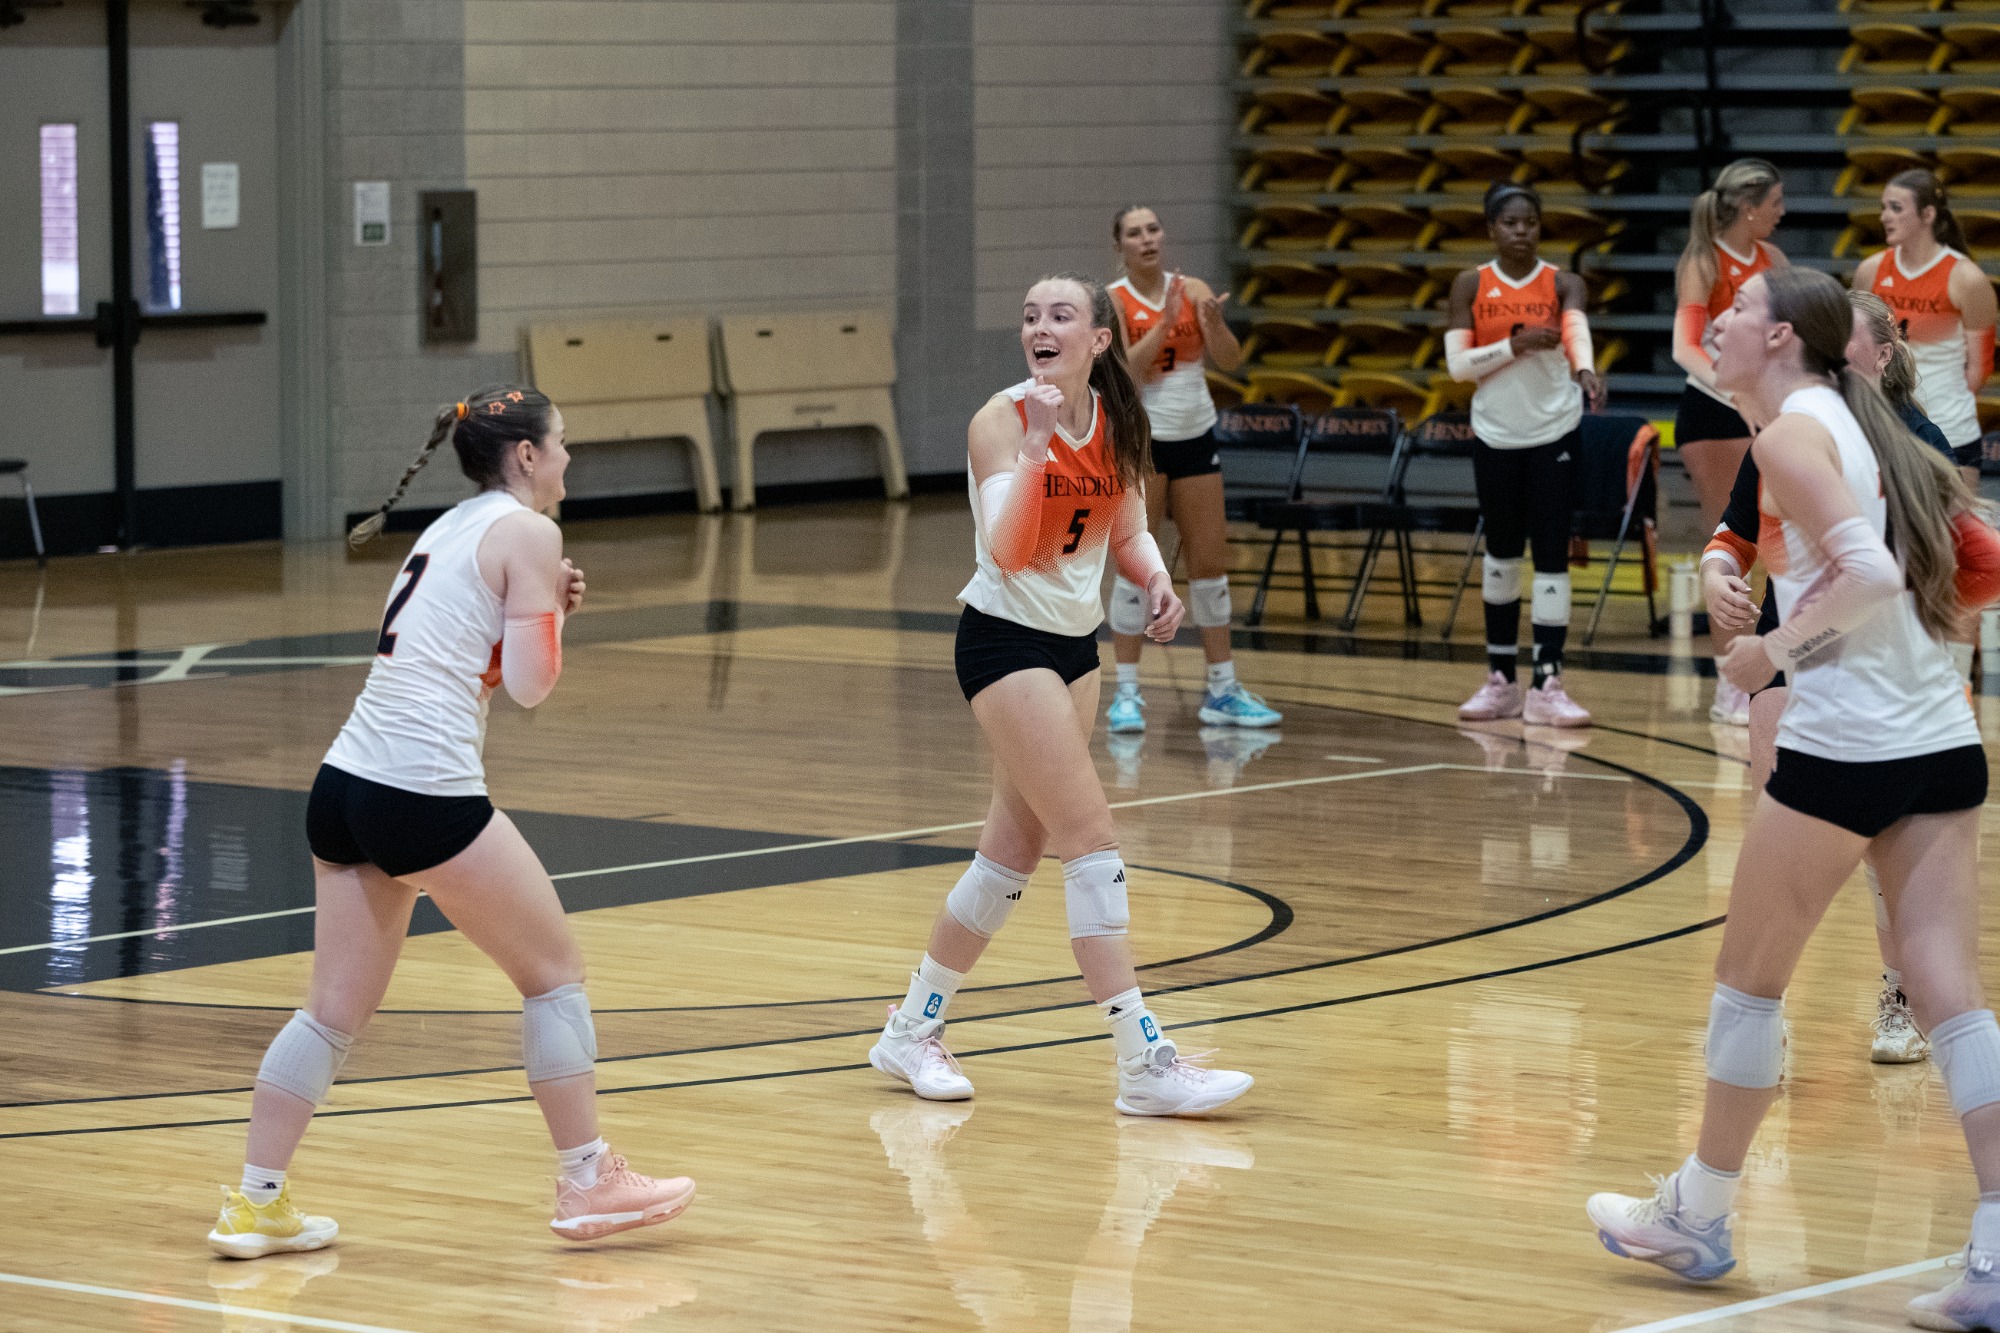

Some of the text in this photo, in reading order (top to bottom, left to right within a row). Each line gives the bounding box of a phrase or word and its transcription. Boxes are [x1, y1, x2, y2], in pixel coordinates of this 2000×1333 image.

[1162, 348, 1176, 372] 3
[1062, 509, 1091, 554] 5
[376, 553, 430, 657] 2
